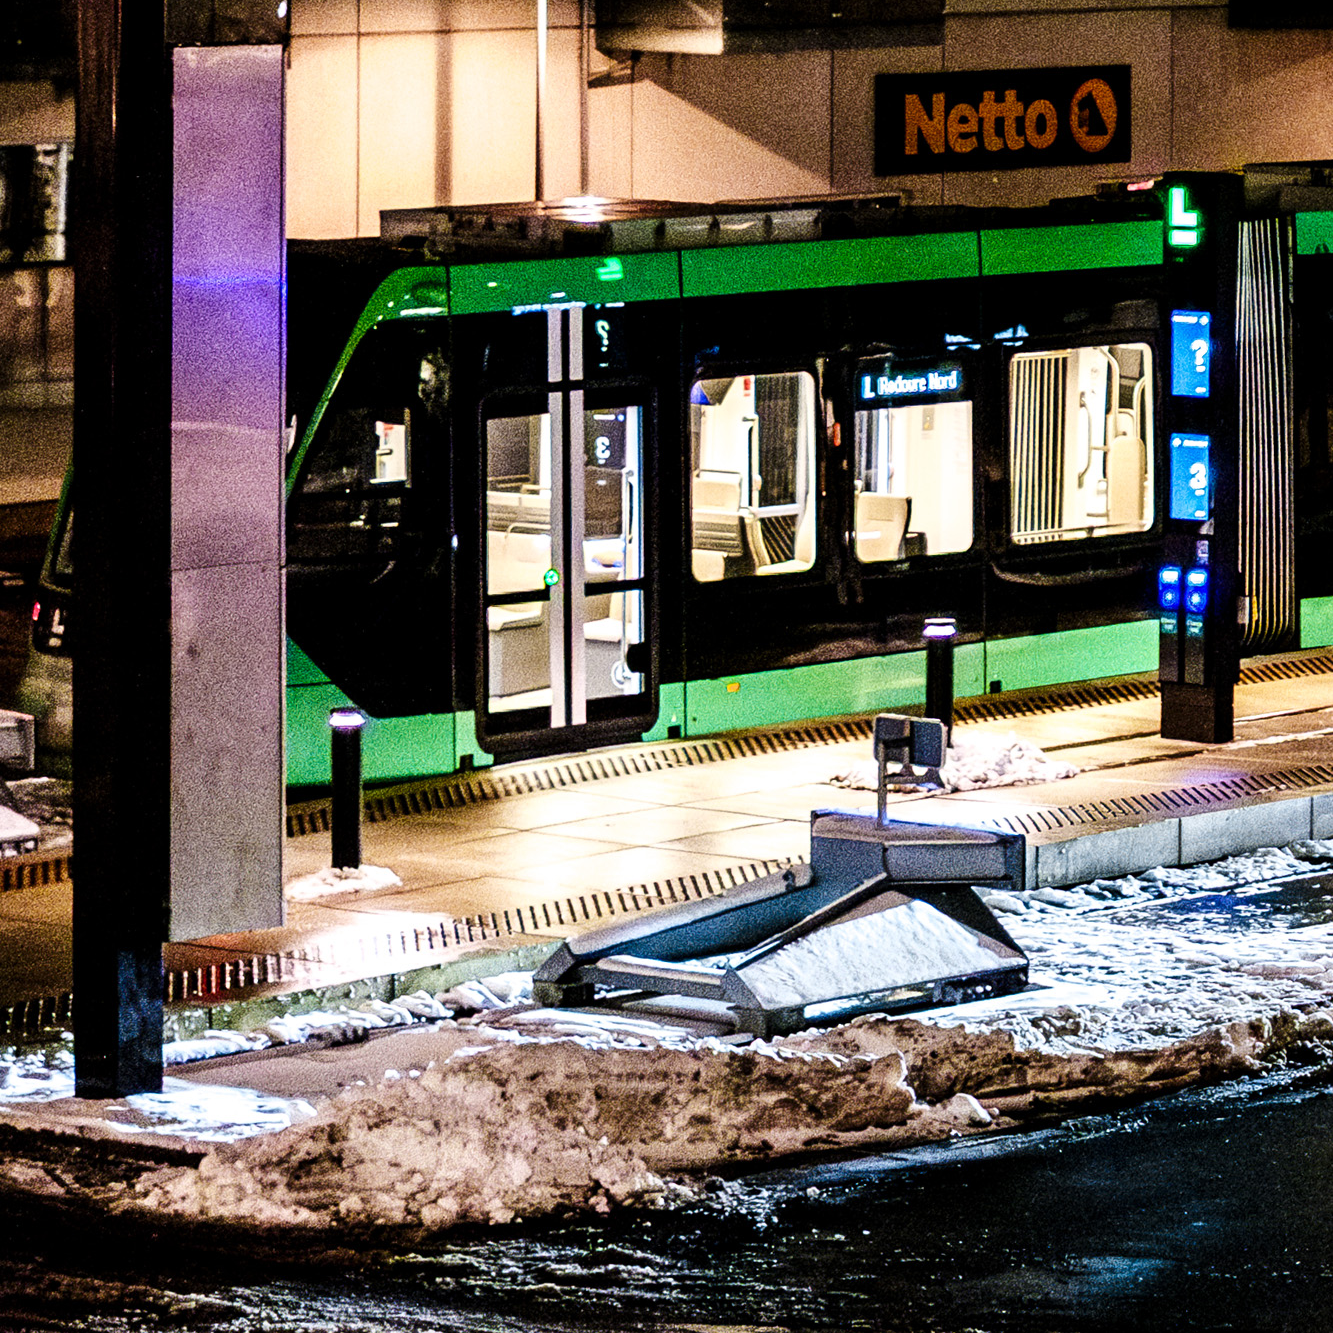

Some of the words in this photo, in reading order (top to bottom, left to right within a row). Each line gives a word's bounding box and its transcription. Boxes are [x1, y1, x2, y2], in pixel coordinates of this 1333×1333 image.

[905, 89, 1058, 155] Netto
[861, 375, 876, 399] L
[927, 370, 959, 390] Nord
